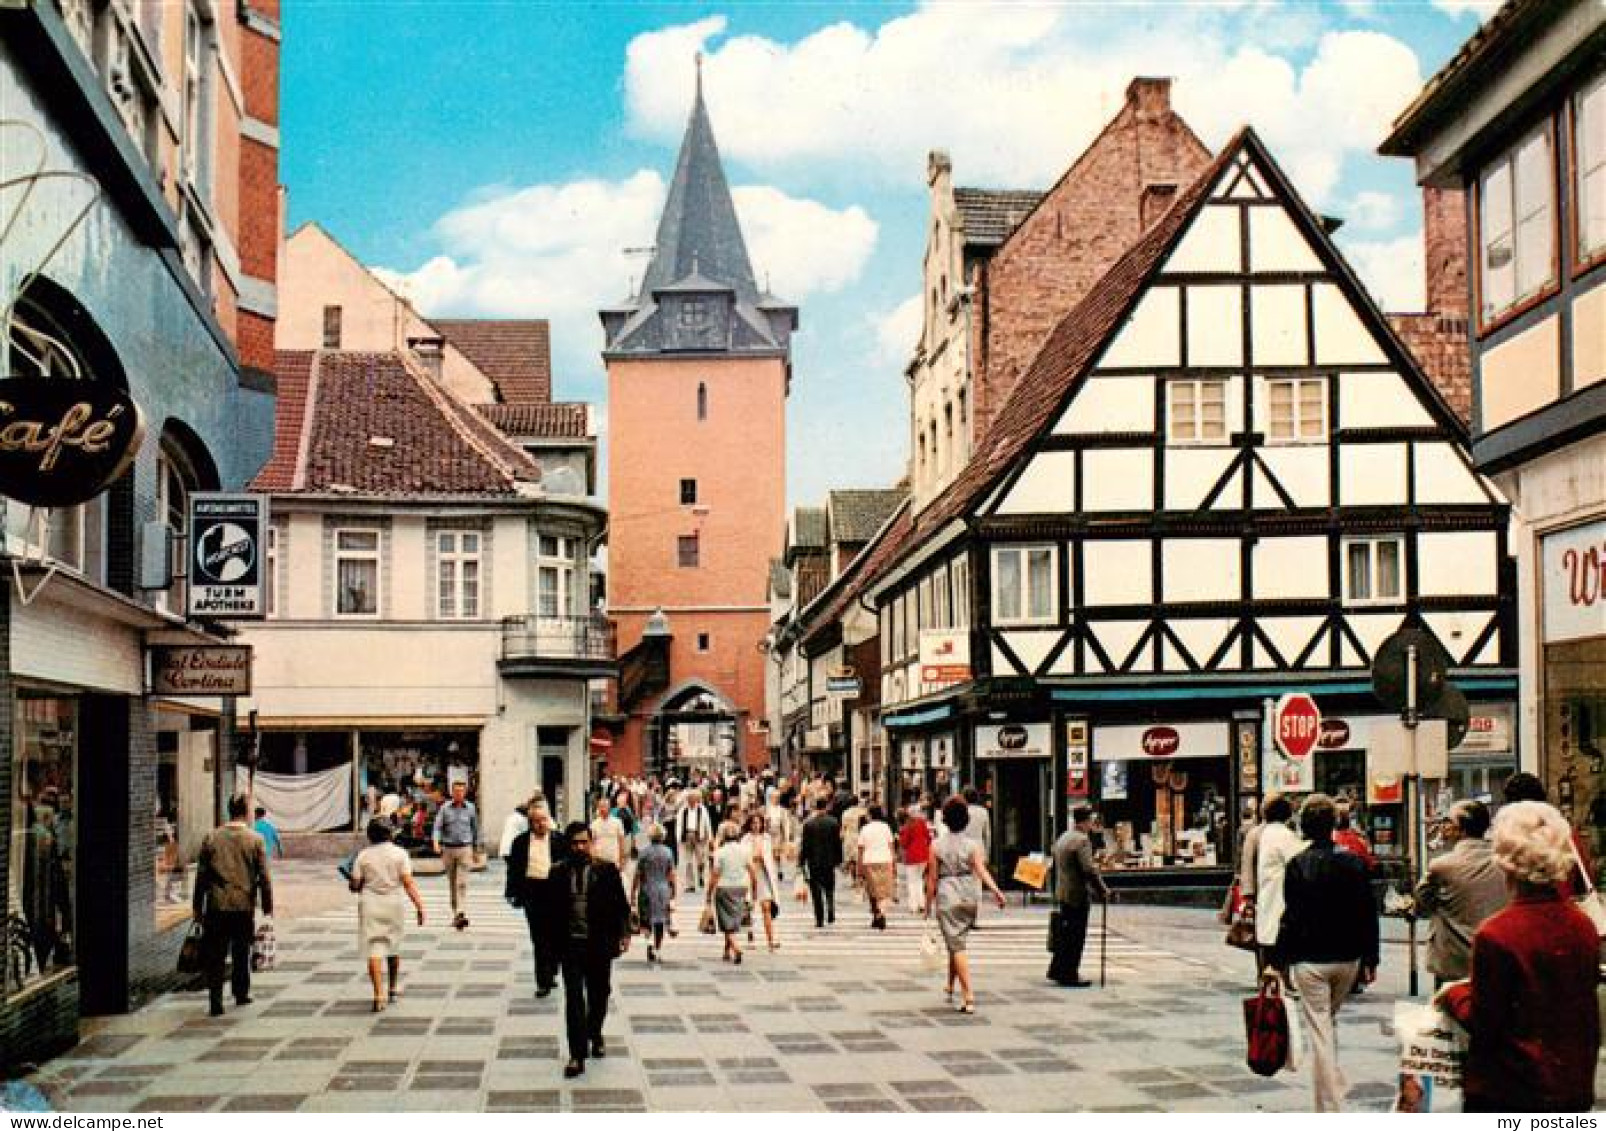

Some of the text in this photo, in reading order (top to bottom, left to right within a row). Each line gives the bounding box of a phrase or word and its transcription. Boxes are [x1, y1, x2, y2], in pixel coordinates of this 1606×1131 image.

[0, 401, 125, 471] afé
[205, 587, 245, 597] TURM
[195, 600, 255, 610] APOTHEKE
[1282, 716, 1315, 738] STOP
